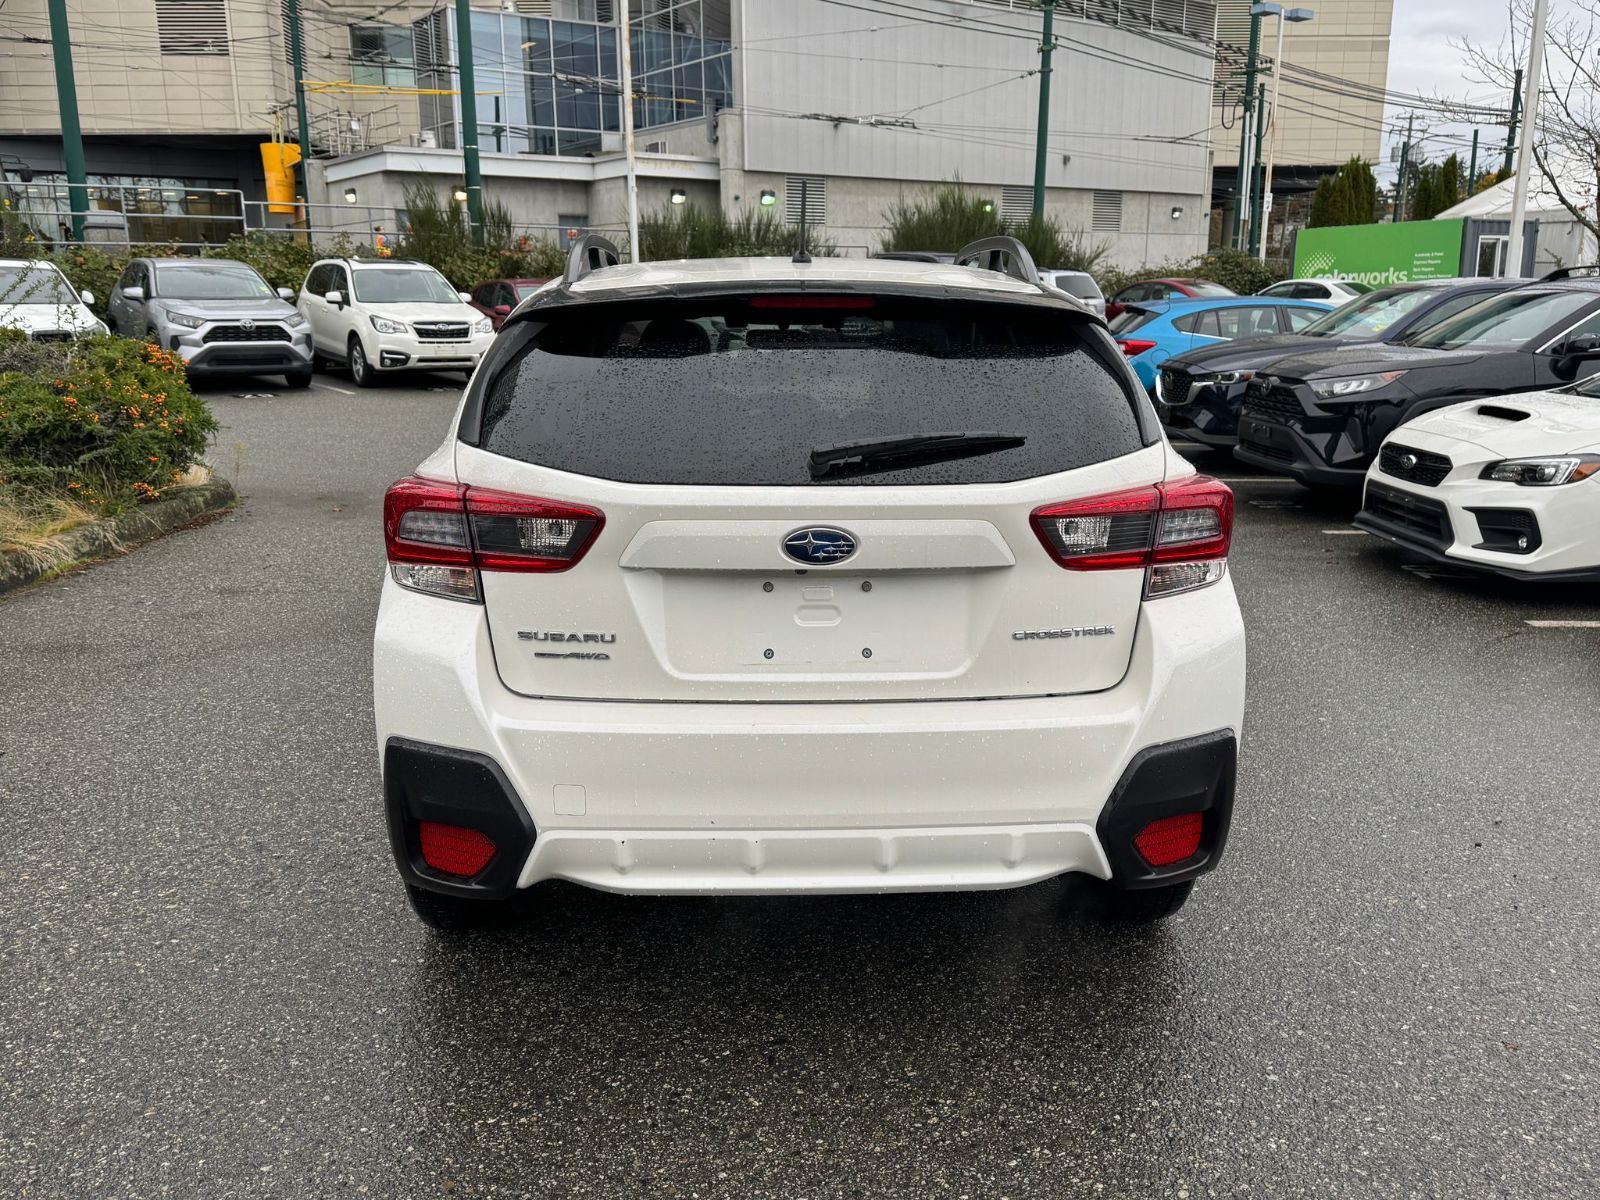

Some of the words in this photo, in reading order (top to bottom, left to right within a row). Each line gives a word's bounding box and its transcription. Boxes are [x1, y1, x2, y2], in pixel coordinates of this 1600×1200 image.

[517, 631, 616, 644] SUBARU
[1012, 625, 1115, 640] CROSSTREK
[562, 652, 610, 660] AWD
